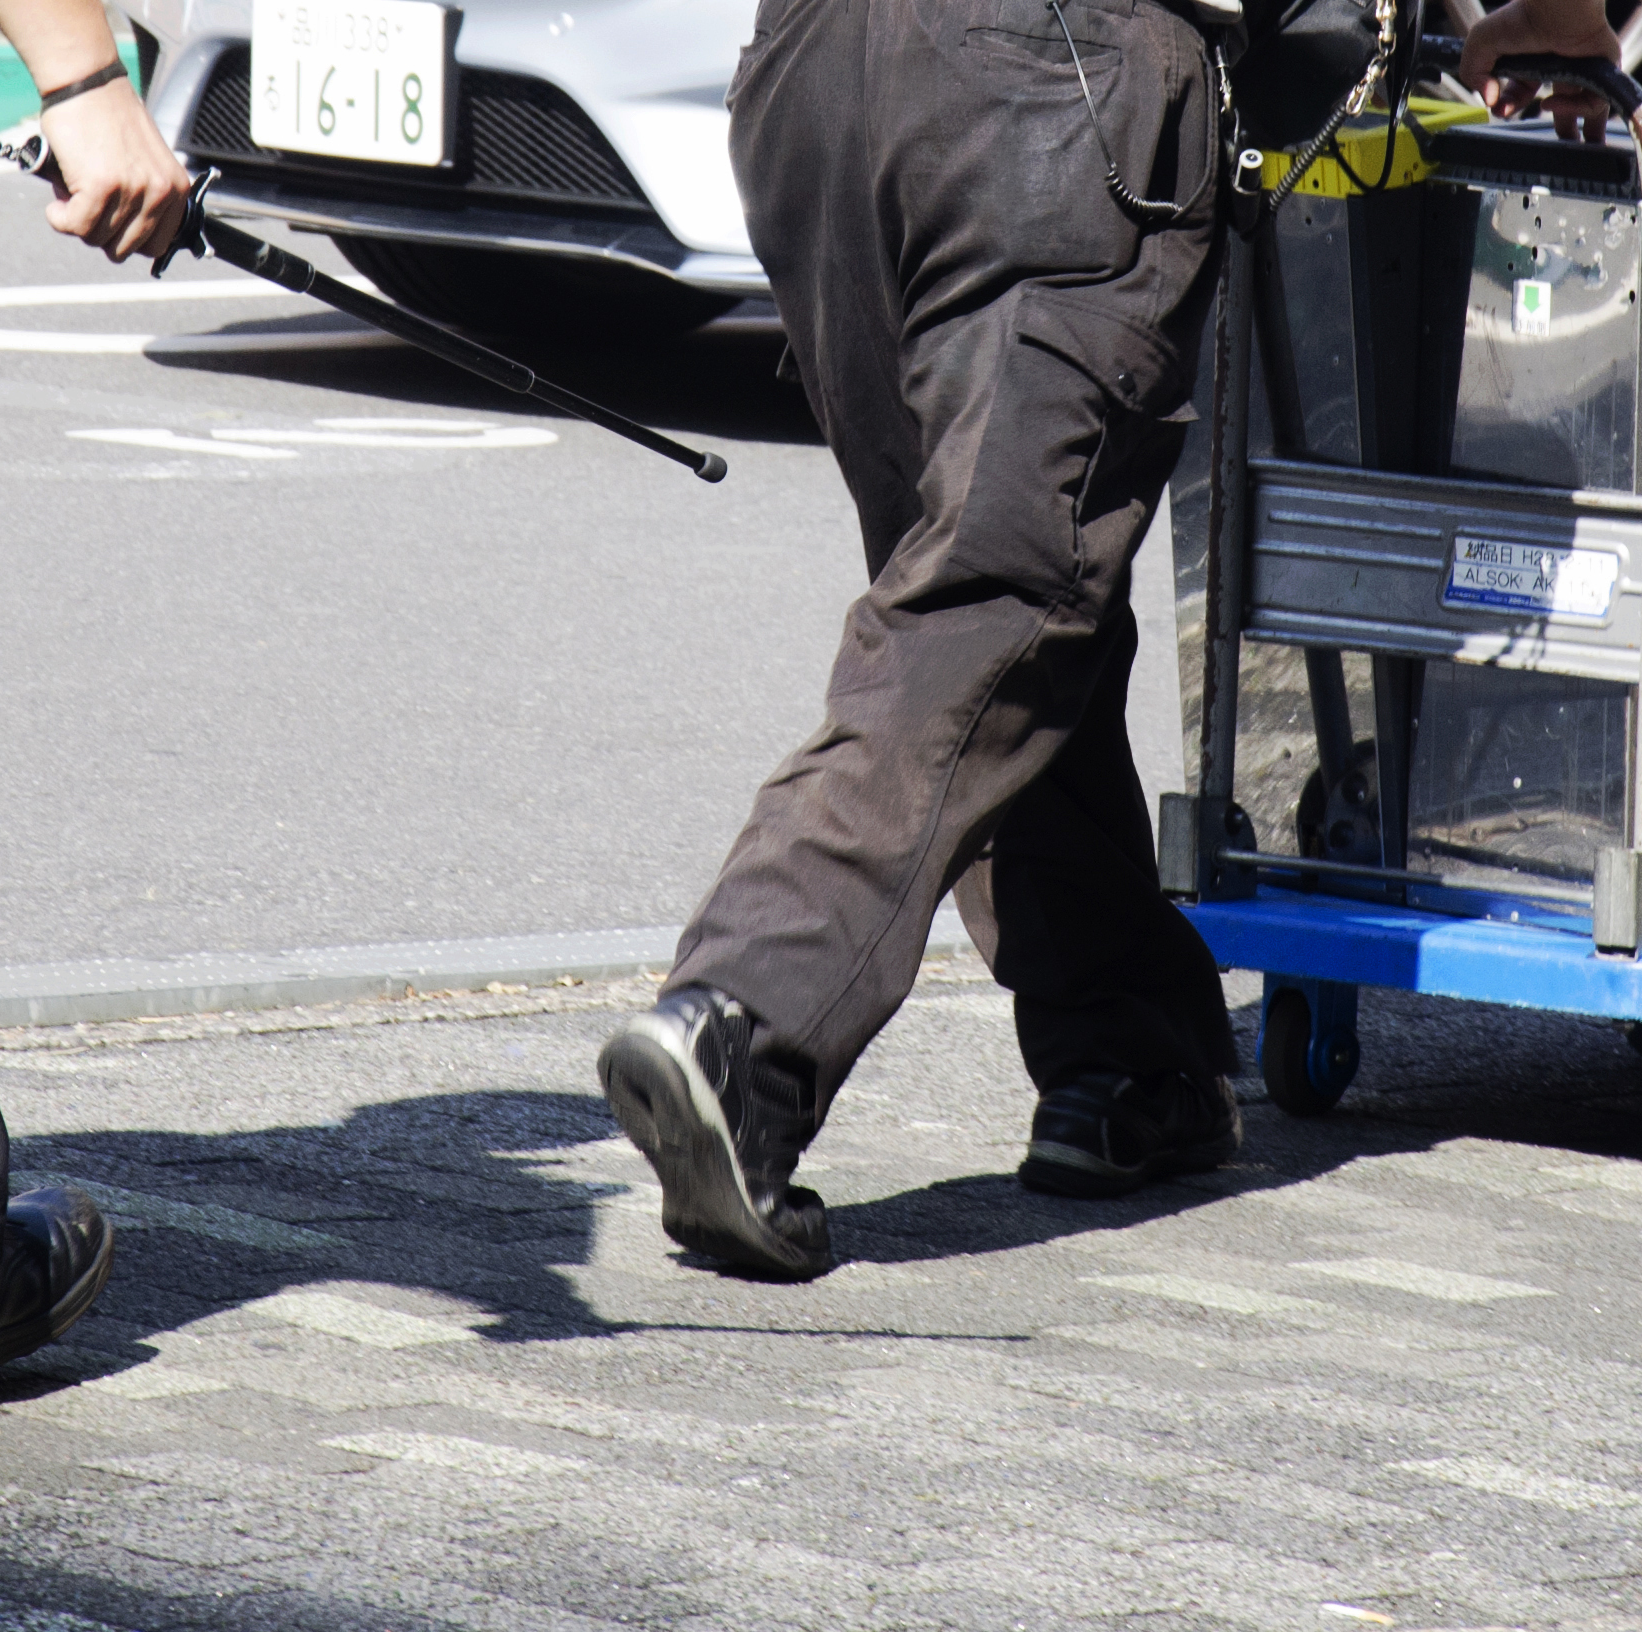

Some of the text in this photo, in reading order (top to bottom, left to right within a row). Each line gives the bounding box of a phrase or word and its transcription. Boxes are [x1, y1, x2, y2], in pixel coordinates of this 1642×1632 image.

[342, 11, 390, 55] 338
[296, 59, 424, 145] 16-18
[1464, 567, 1520, 589] ALSOK
